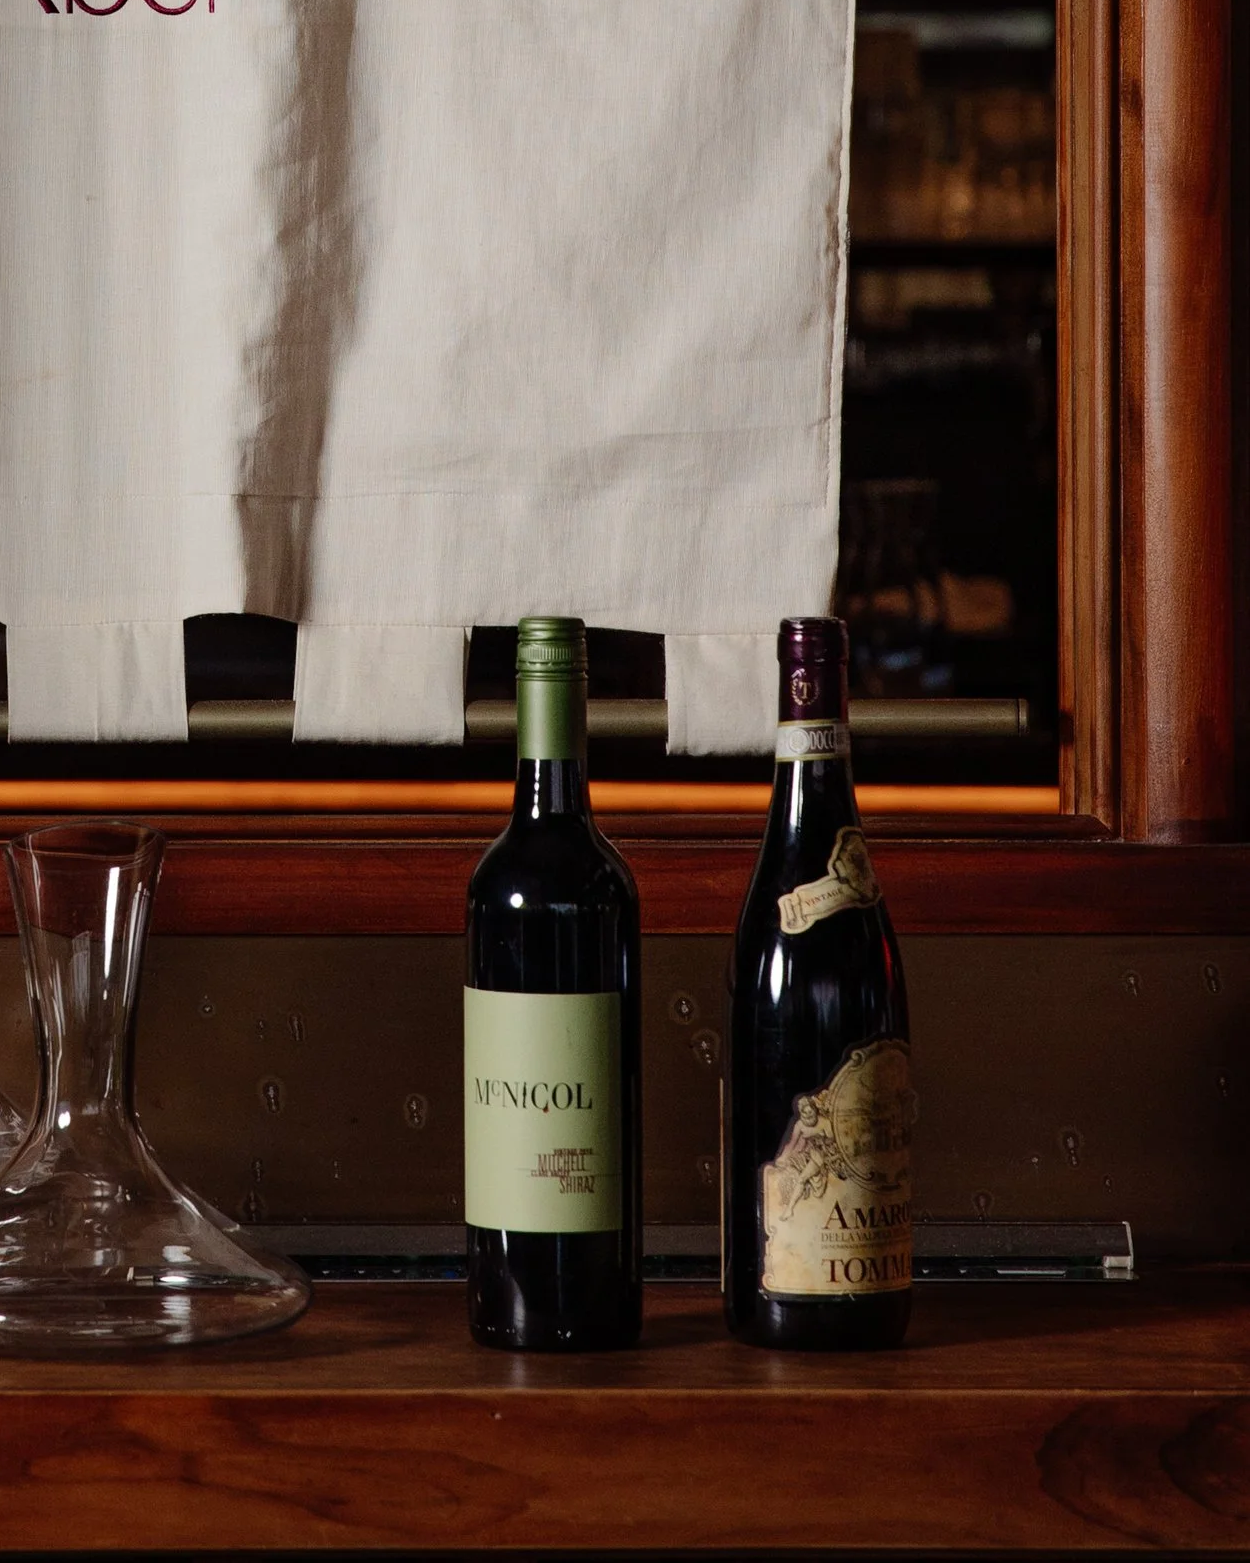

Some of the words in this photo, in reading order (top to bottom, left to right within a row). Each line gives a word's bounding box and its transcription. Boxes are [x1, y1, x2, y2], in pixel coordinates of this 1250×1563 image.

[804, 887, 844, 907] VINTAGE
[537, 1153, 586, 1172] MITCHELL
[559, 1176, 595, 1194] SHIRAZ
